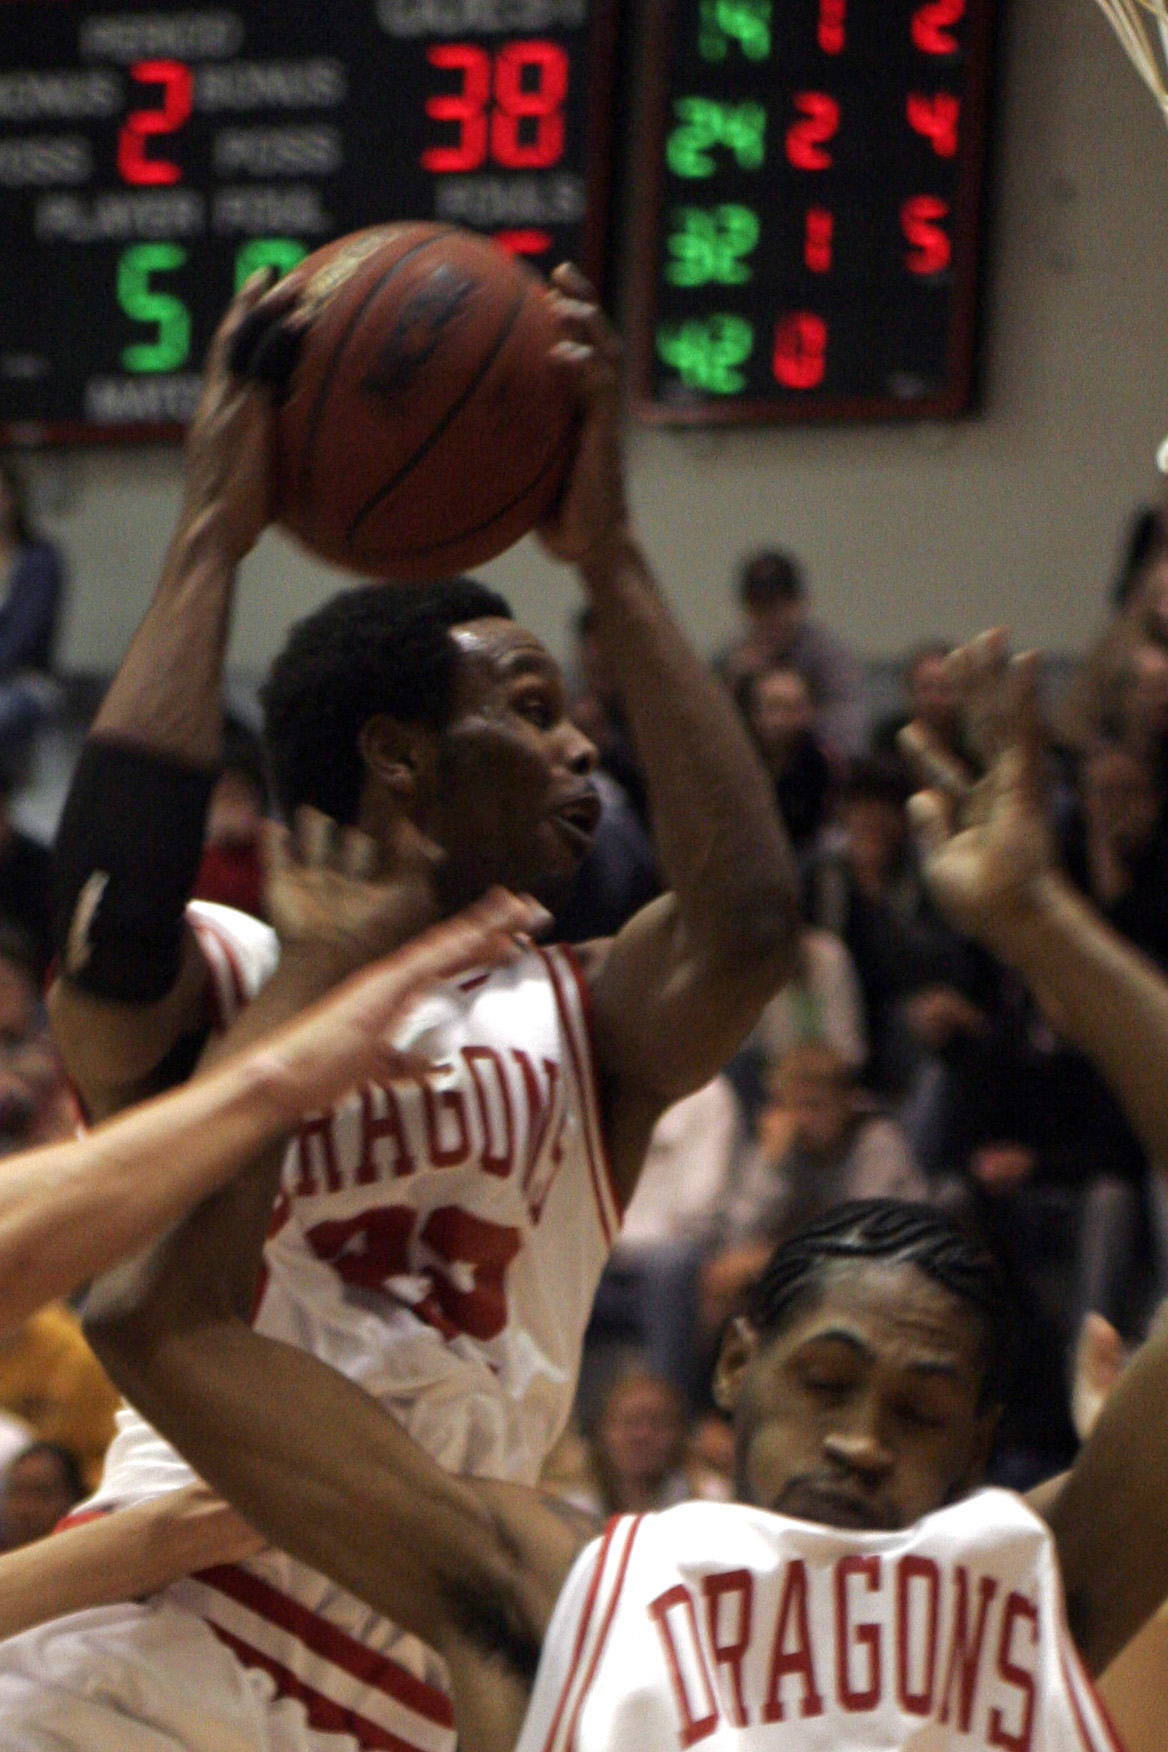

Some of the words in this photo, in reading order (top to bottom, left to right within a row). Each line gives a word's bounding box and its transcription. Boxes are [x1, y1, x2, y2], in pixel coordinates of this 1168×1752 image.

[118, 59, 193, 185] 2
[420, 41, 568, 172] 38
[786, 91, 840, 171] 2
[907, 90, 959, 158] 4
[805, 207, 833, 274] 1
[900, 196, 951, 275] 5
[117, 242, 190, 373] 5
